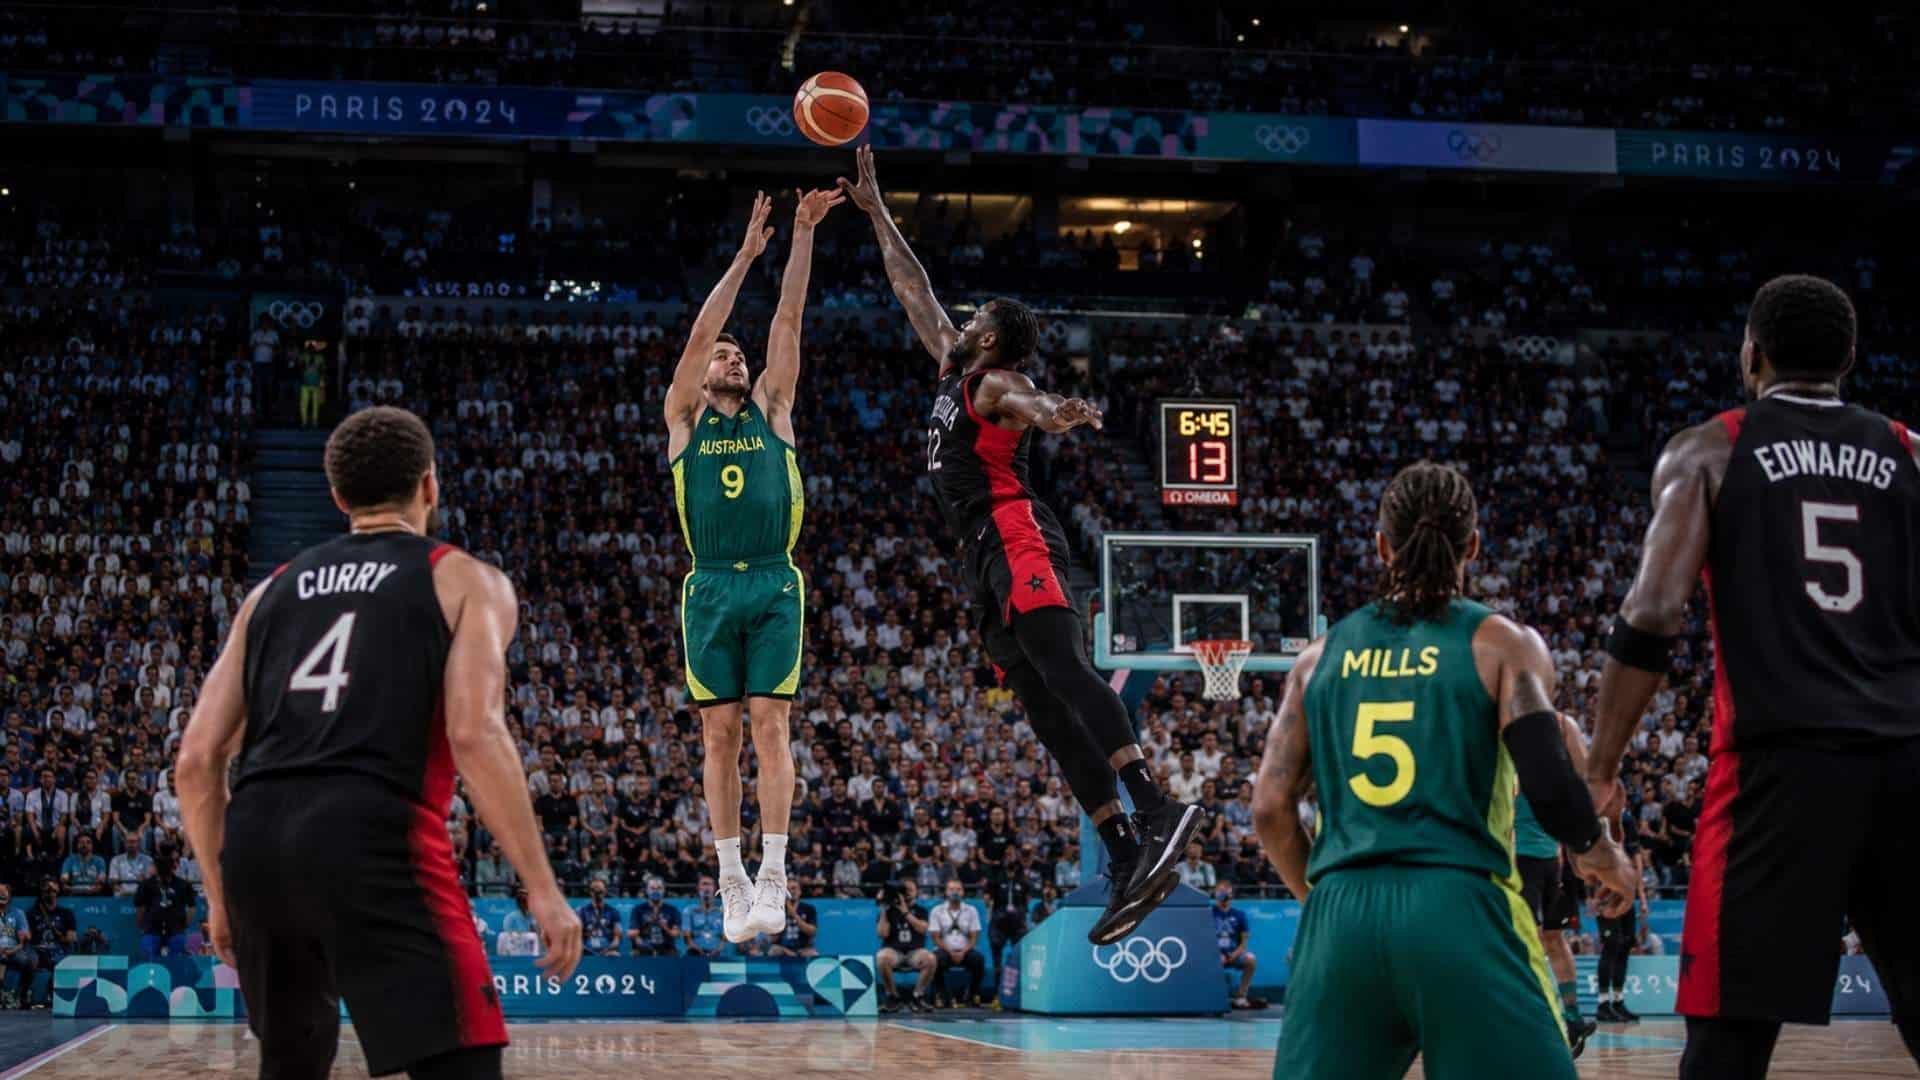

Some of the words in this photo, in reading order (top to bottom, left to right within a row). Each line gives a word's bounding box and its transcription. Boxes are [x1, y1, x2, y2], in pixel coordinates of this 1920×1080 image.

[296, 93, 403, 121] PARIS
[419, 96, 516, 125] 2024
[1653, 142, 1745, 168] PARIS
[1180, 411, 1230, 437] 6:45
[698, 435, 766, 456] AUSTRALIA
[1189, 441, 1227, 482] 13
[721, 464, 745, 499] 9
[1754, 439, 1897, 490] EDWARDS
[1801, 499, 1864, 612] 5
[297, 561, 398, 600] CURRY
[289, 611, 356, 713] 4
[1341, 645, 1440, 679] MILLS
[1348, 701, 1416, 807] 5
[493, 974, 561, 995] ARIS
[575, 974, 656, 995] 2024
[1839, 974, 1871, 994] 24
